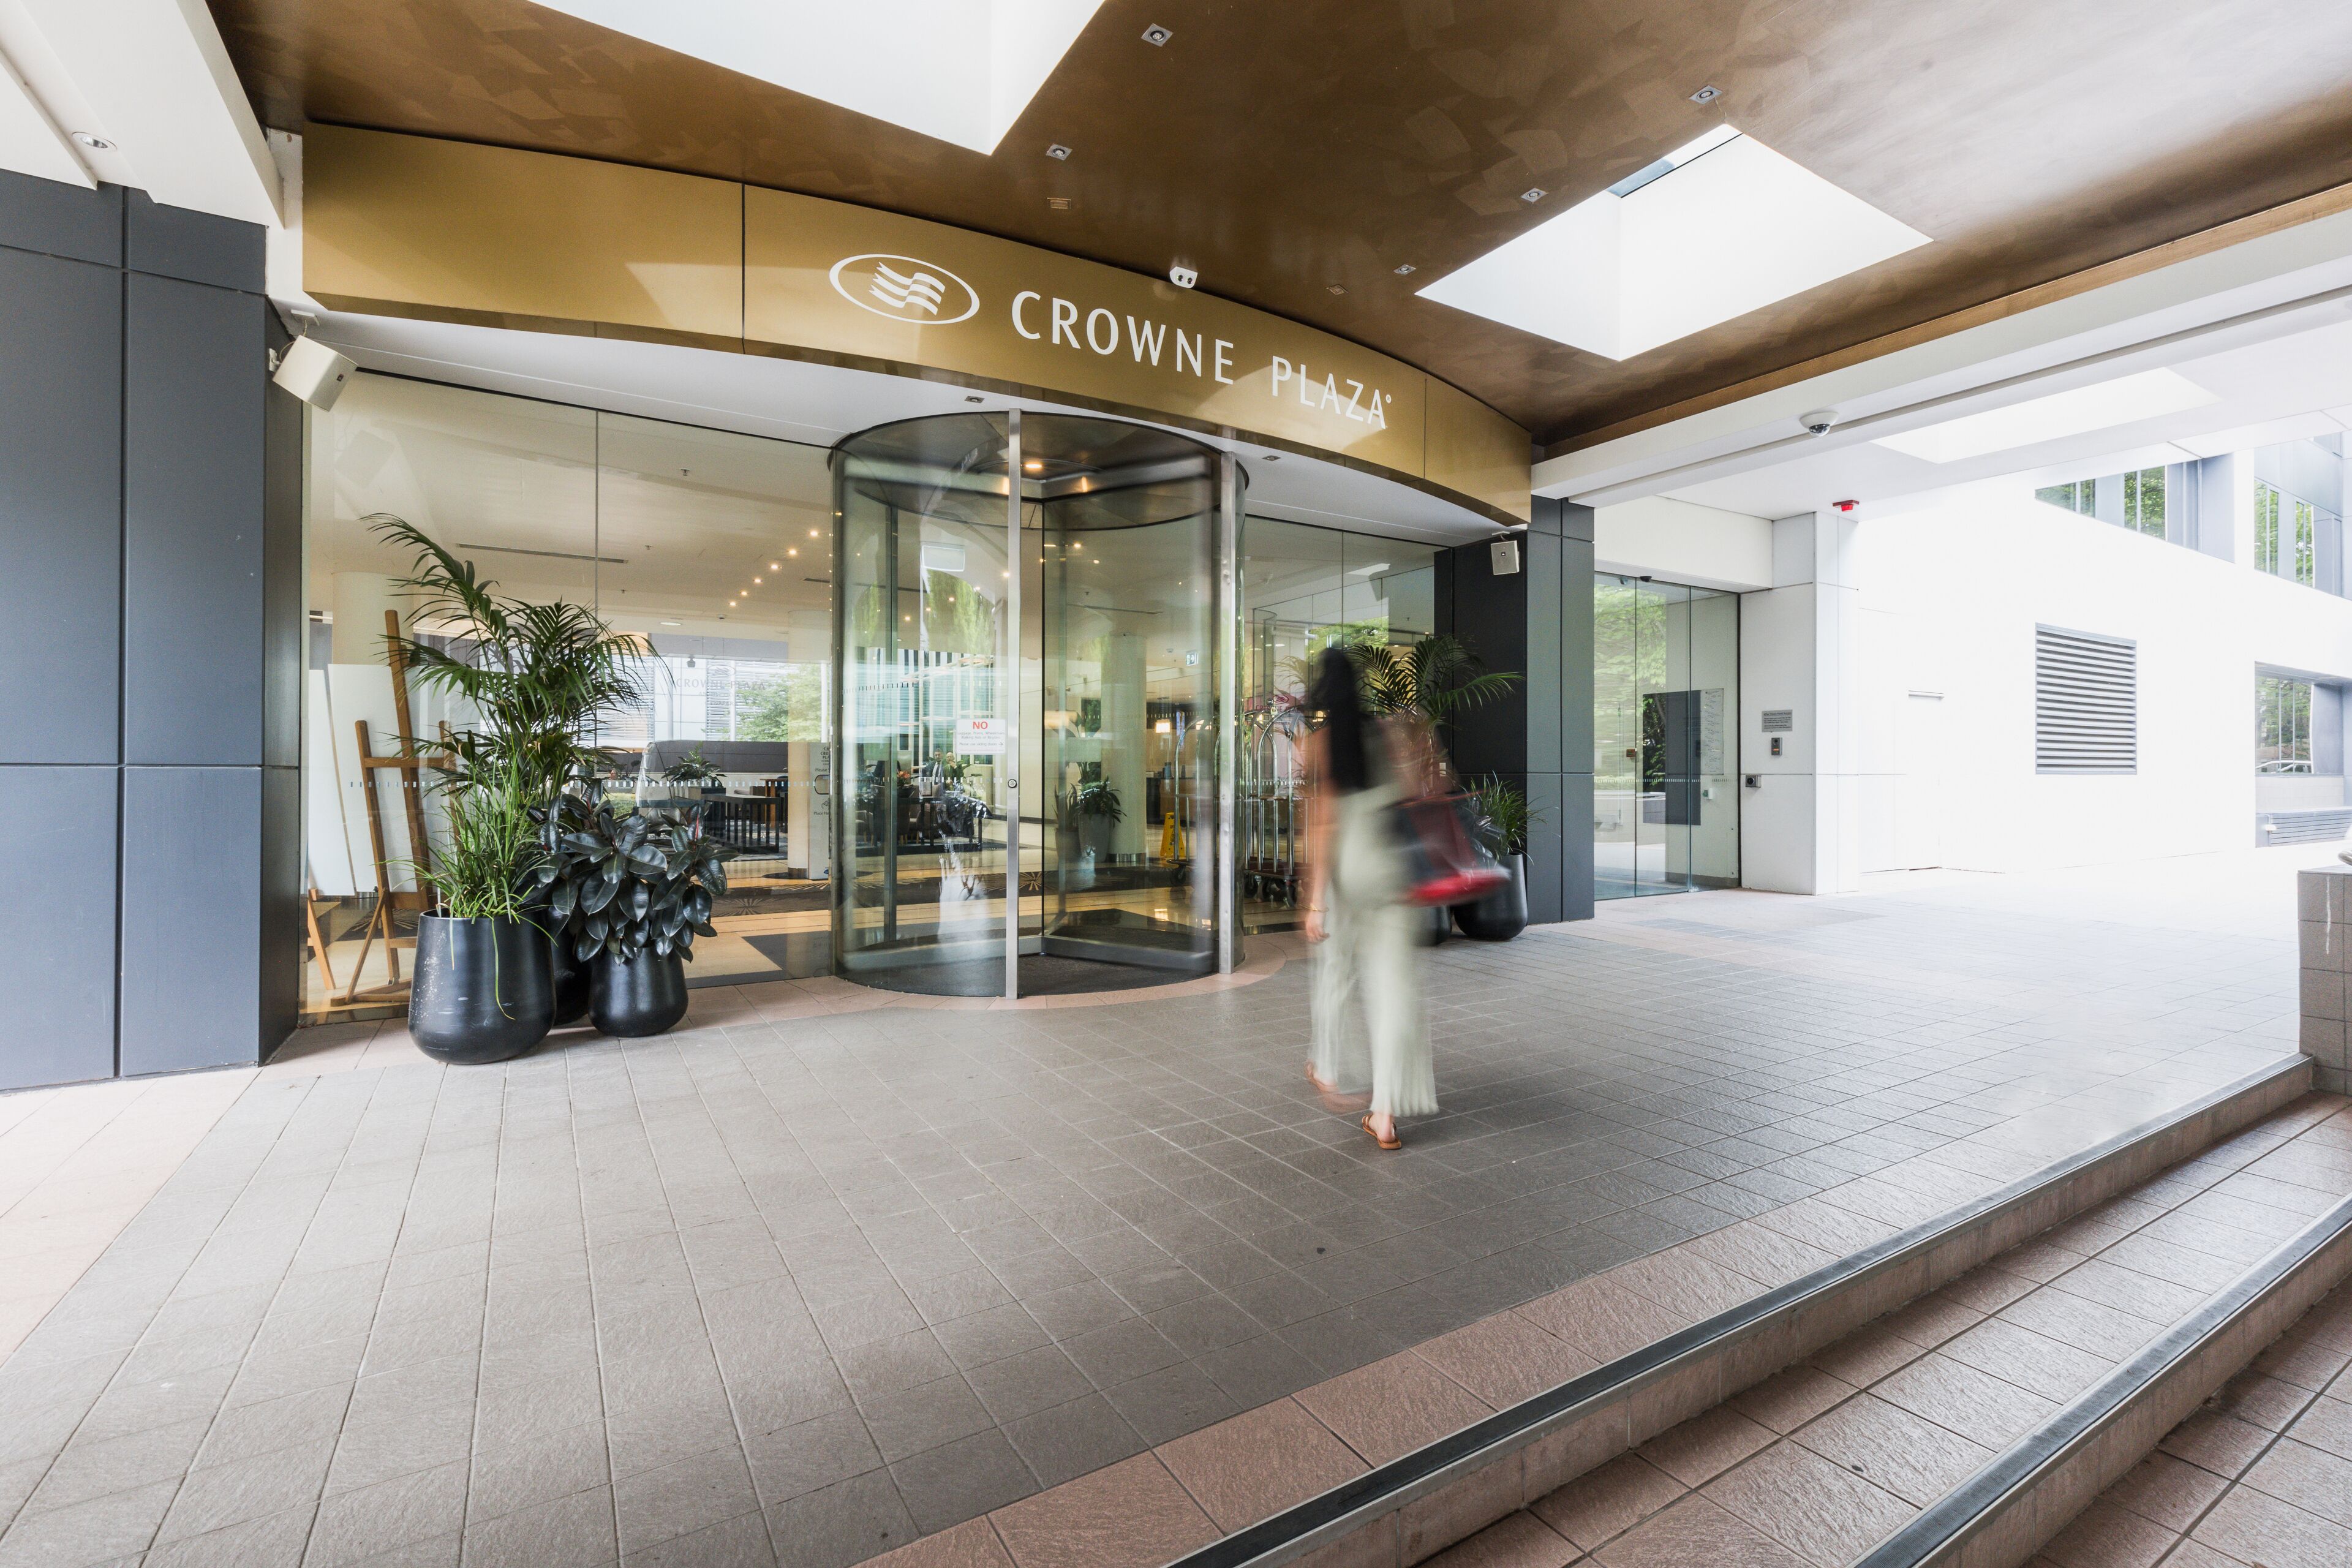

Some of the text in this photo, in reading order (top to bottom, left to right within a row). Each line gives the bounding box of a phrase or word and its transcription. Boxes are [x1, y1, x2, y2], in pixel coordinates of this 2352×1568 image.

[1012, 291, 1387, 429] CROWNE PLAZA
[973, 721, 988, 729] NO
